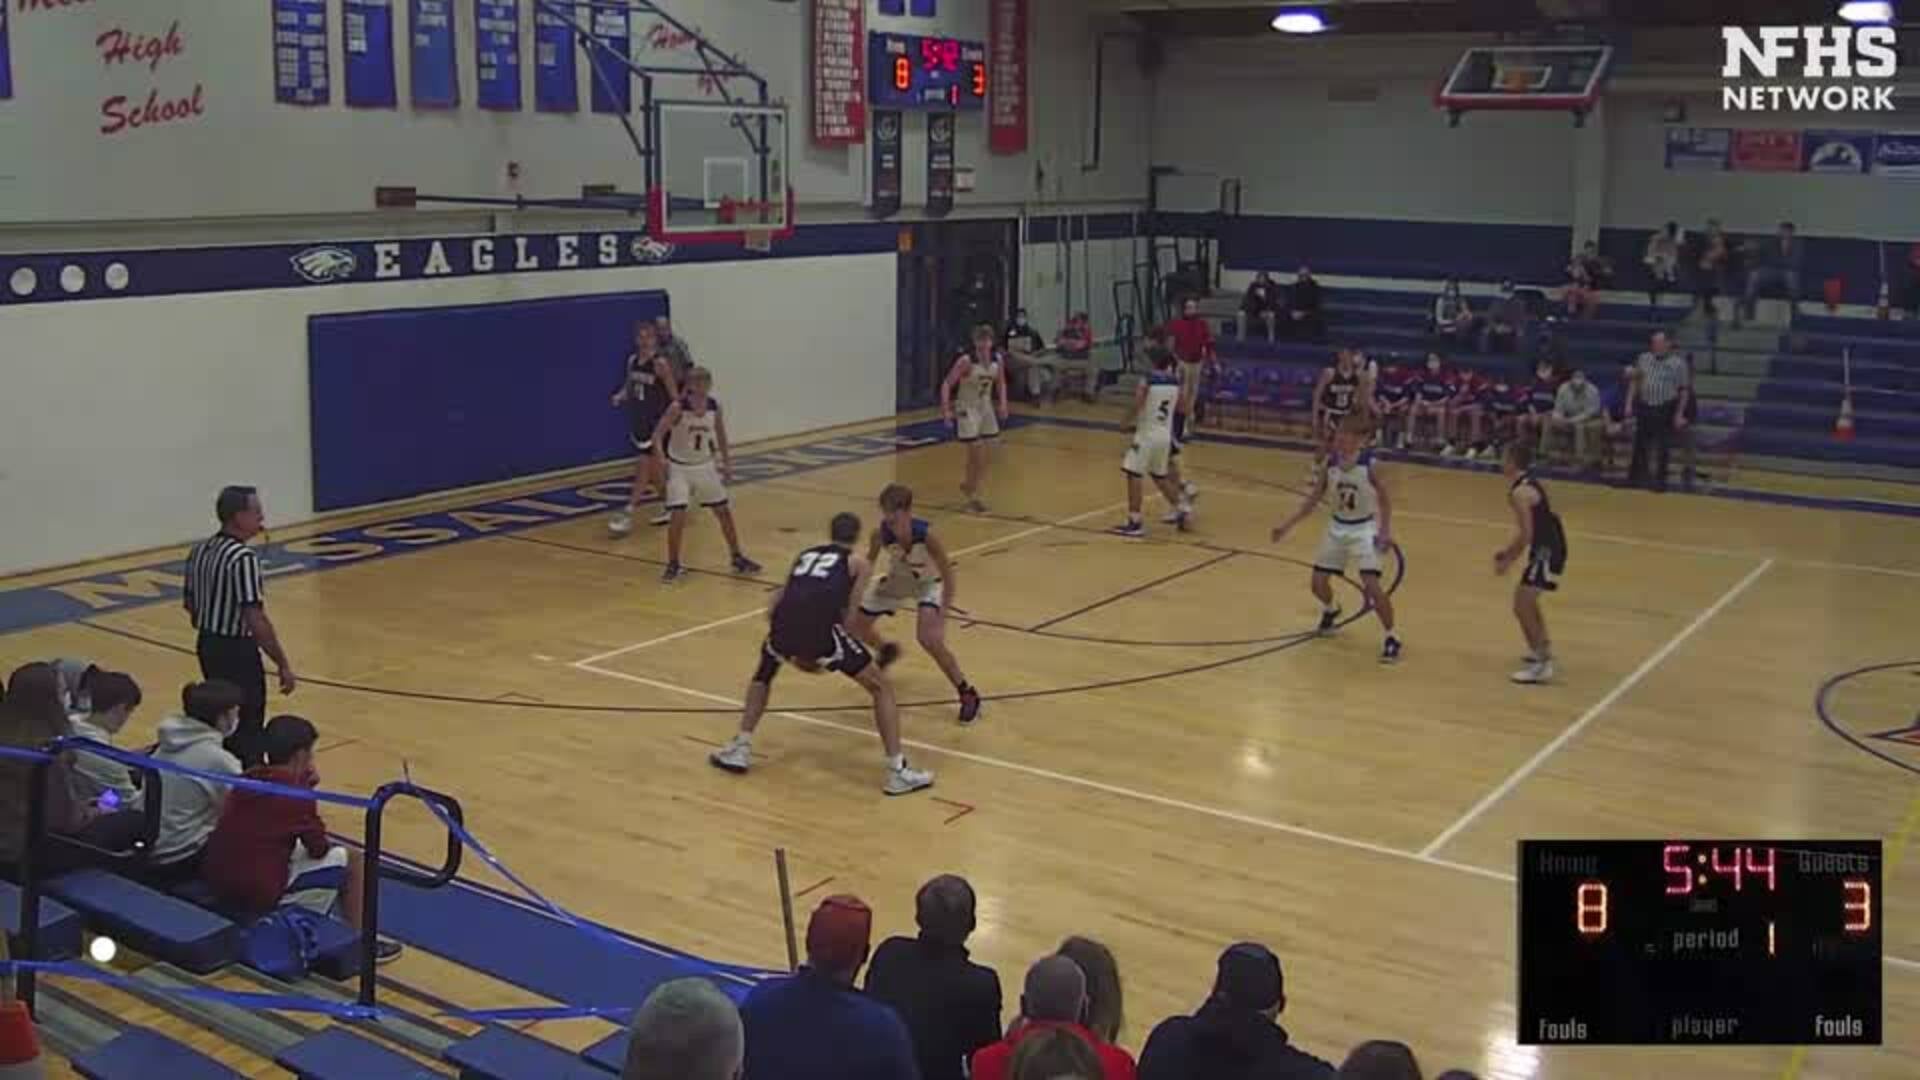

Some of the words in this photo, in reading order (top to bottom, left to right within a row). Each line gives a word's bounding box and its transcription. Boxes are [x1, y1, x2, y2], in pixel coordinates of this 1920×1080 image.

[95, 19, 183, 71] High
[895, 56, 910, 91] 8
[973, 64, 985, 95] 3
[100, 82, 204, 135] School
[950, 84, 958, 105] 1
[374, 233, 617, 278] EAGLES
[1157, 399, 1169, 421] 5
[793, 551, 840, 578] 32
